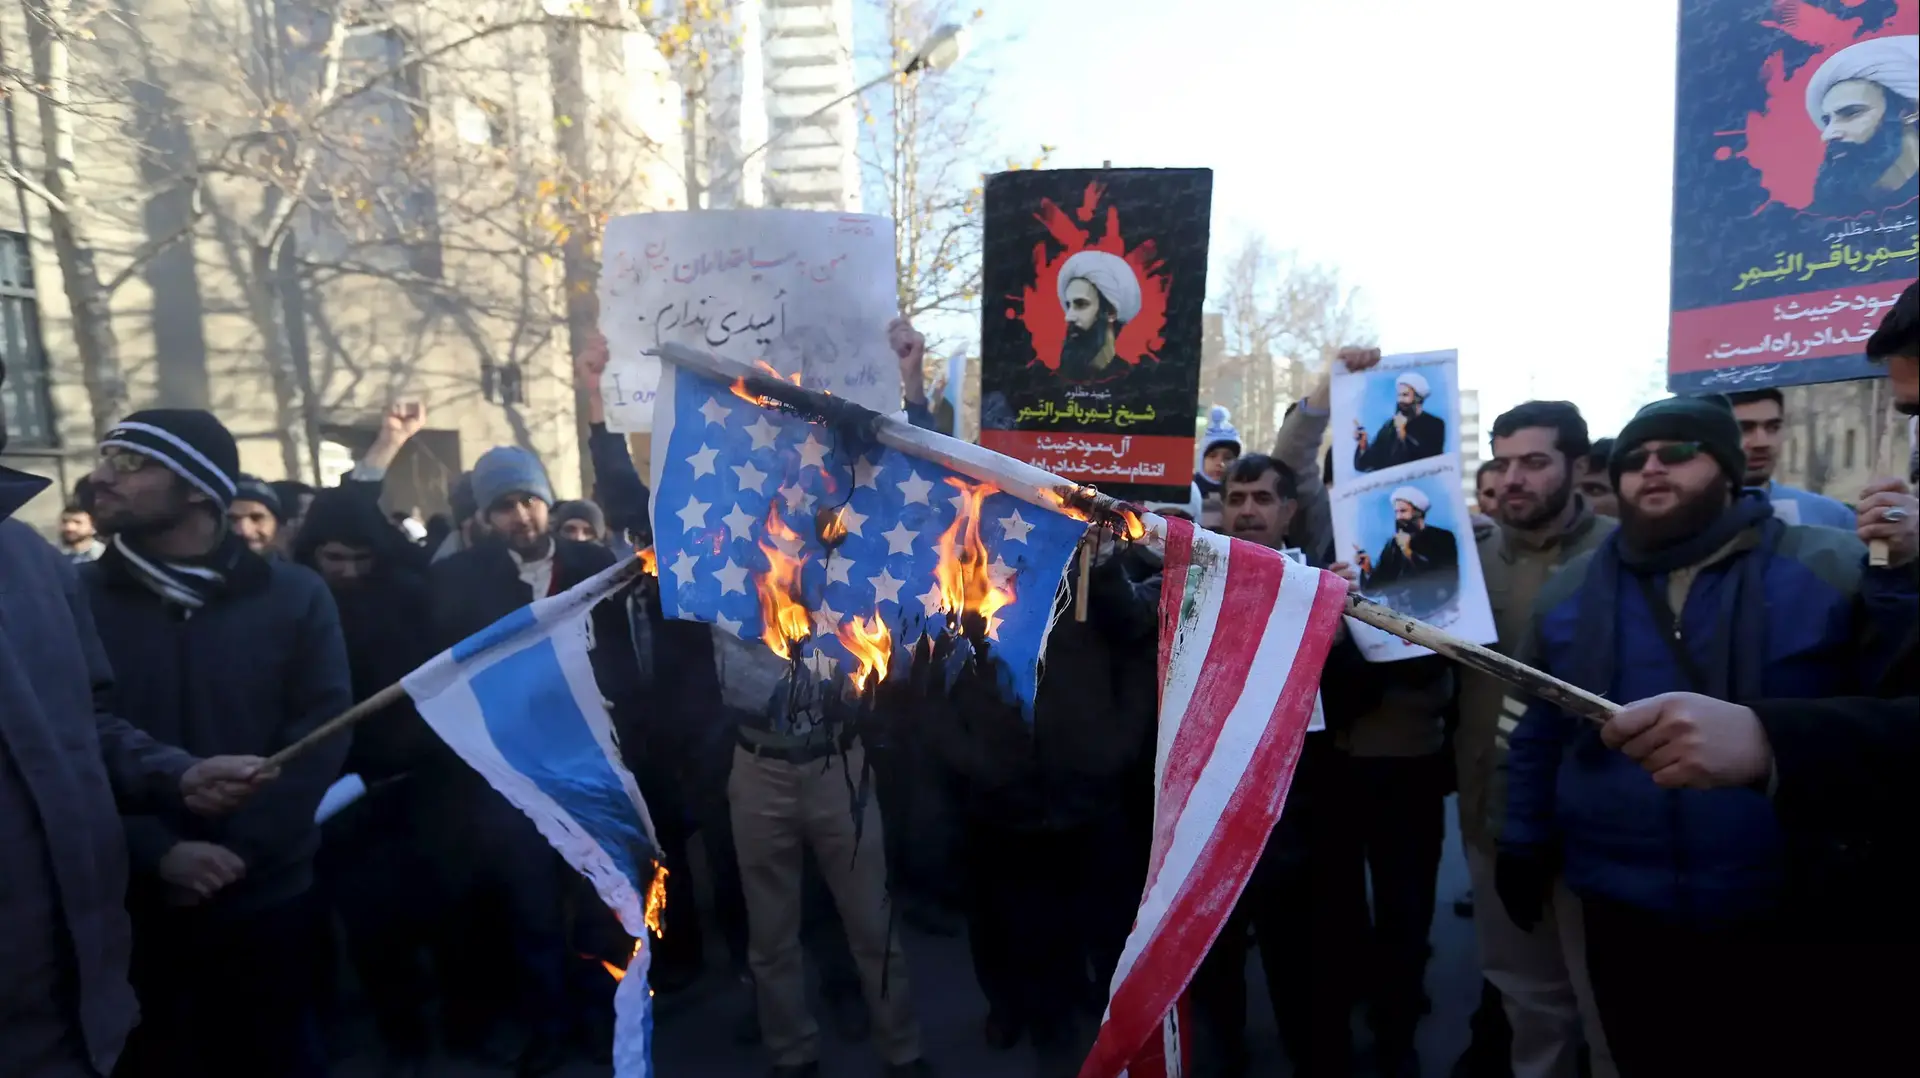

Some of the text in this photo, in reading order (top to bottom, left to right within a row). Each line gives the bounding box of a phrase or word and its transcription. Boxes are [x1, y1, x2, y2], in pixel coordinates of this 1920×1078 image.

[1822, 214, 1917, 244] شهید مظلوم
[1797, 243, 1863, 281] باقر
[1064, 386, 1089, 400] مظلوم
[1050, 399, 1085, 424] باقر
[1114, 403, 1156, 427] شیخ
[1077, 439, 1113, 457] سعود
[1111, 435, 1133, 458] آل
[1064, 459, 1091, 473] خدا
[1090, 460, 1131, 475] سخت
[1130, 461, 1166, 483] انتقام
